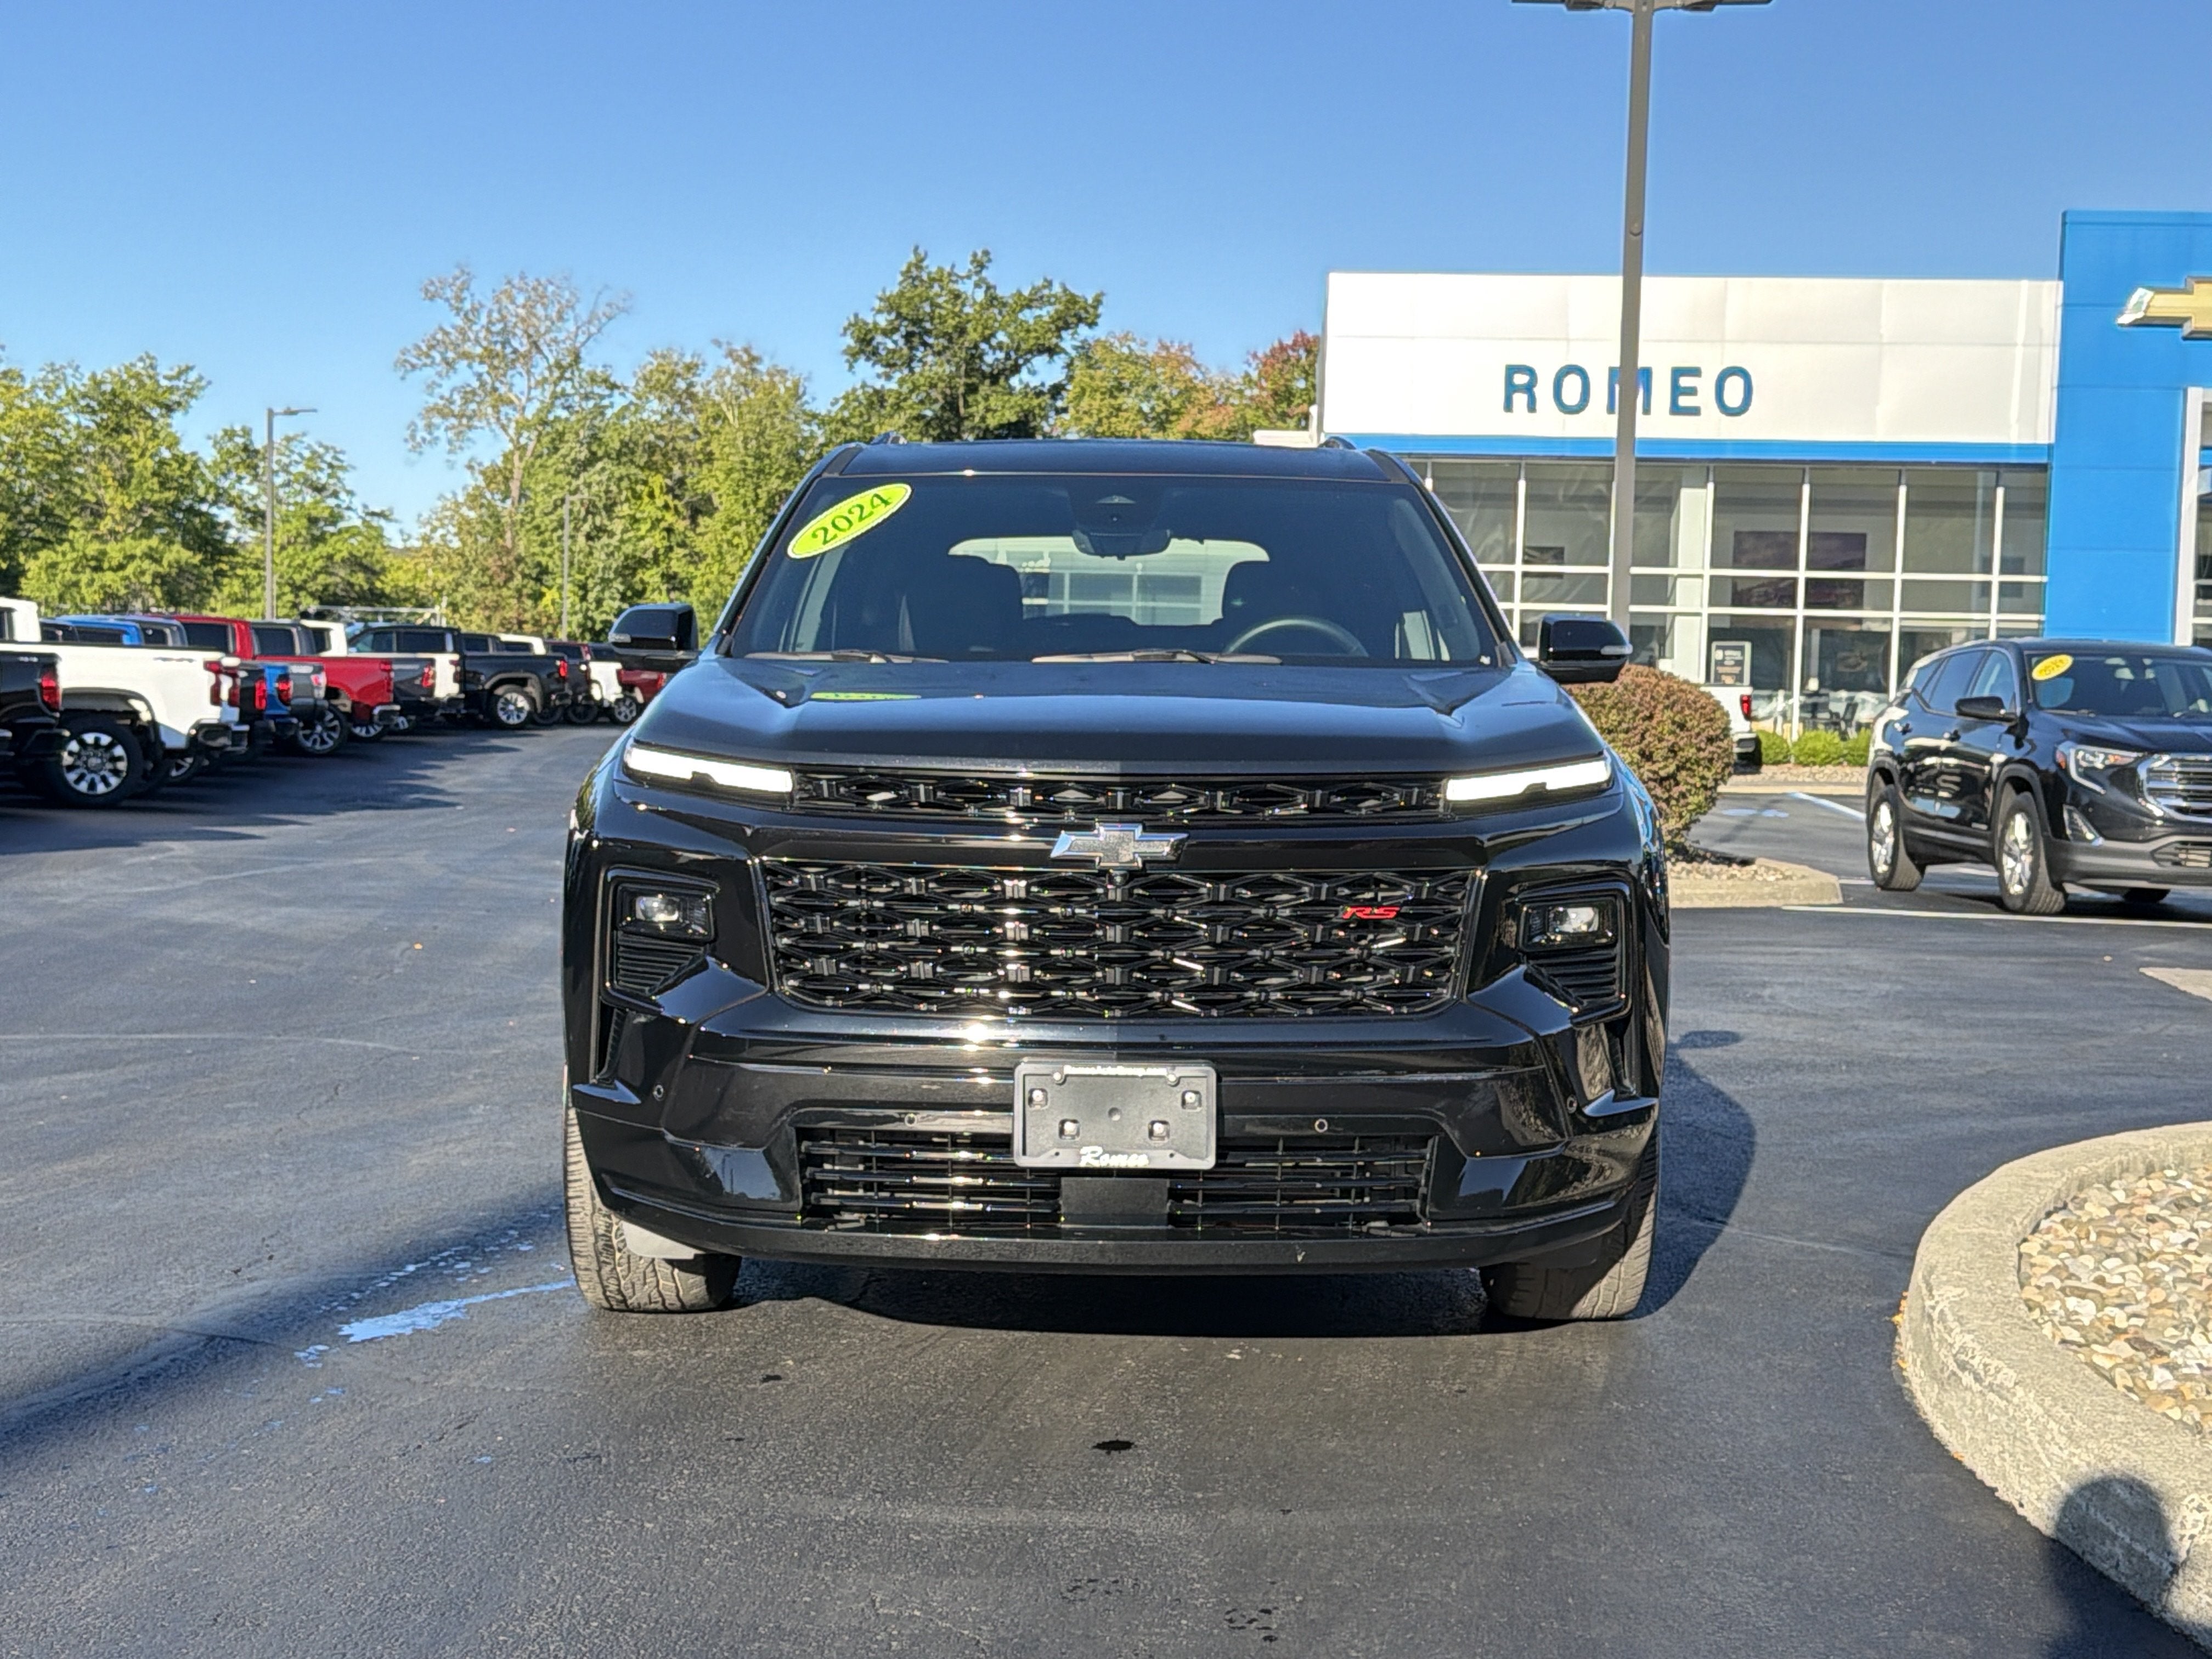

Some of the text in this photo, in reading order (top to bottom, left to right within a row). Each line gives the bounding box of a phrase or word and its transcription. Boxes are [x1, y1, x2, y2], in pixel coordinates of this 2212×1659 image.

[1503, 364, 1753, 416] ROMEO
[811, 493, 893, 545] 2024
[1342, 905, 1401, 919] RS
[1079, 1146, 1149, 1167] Romeo
